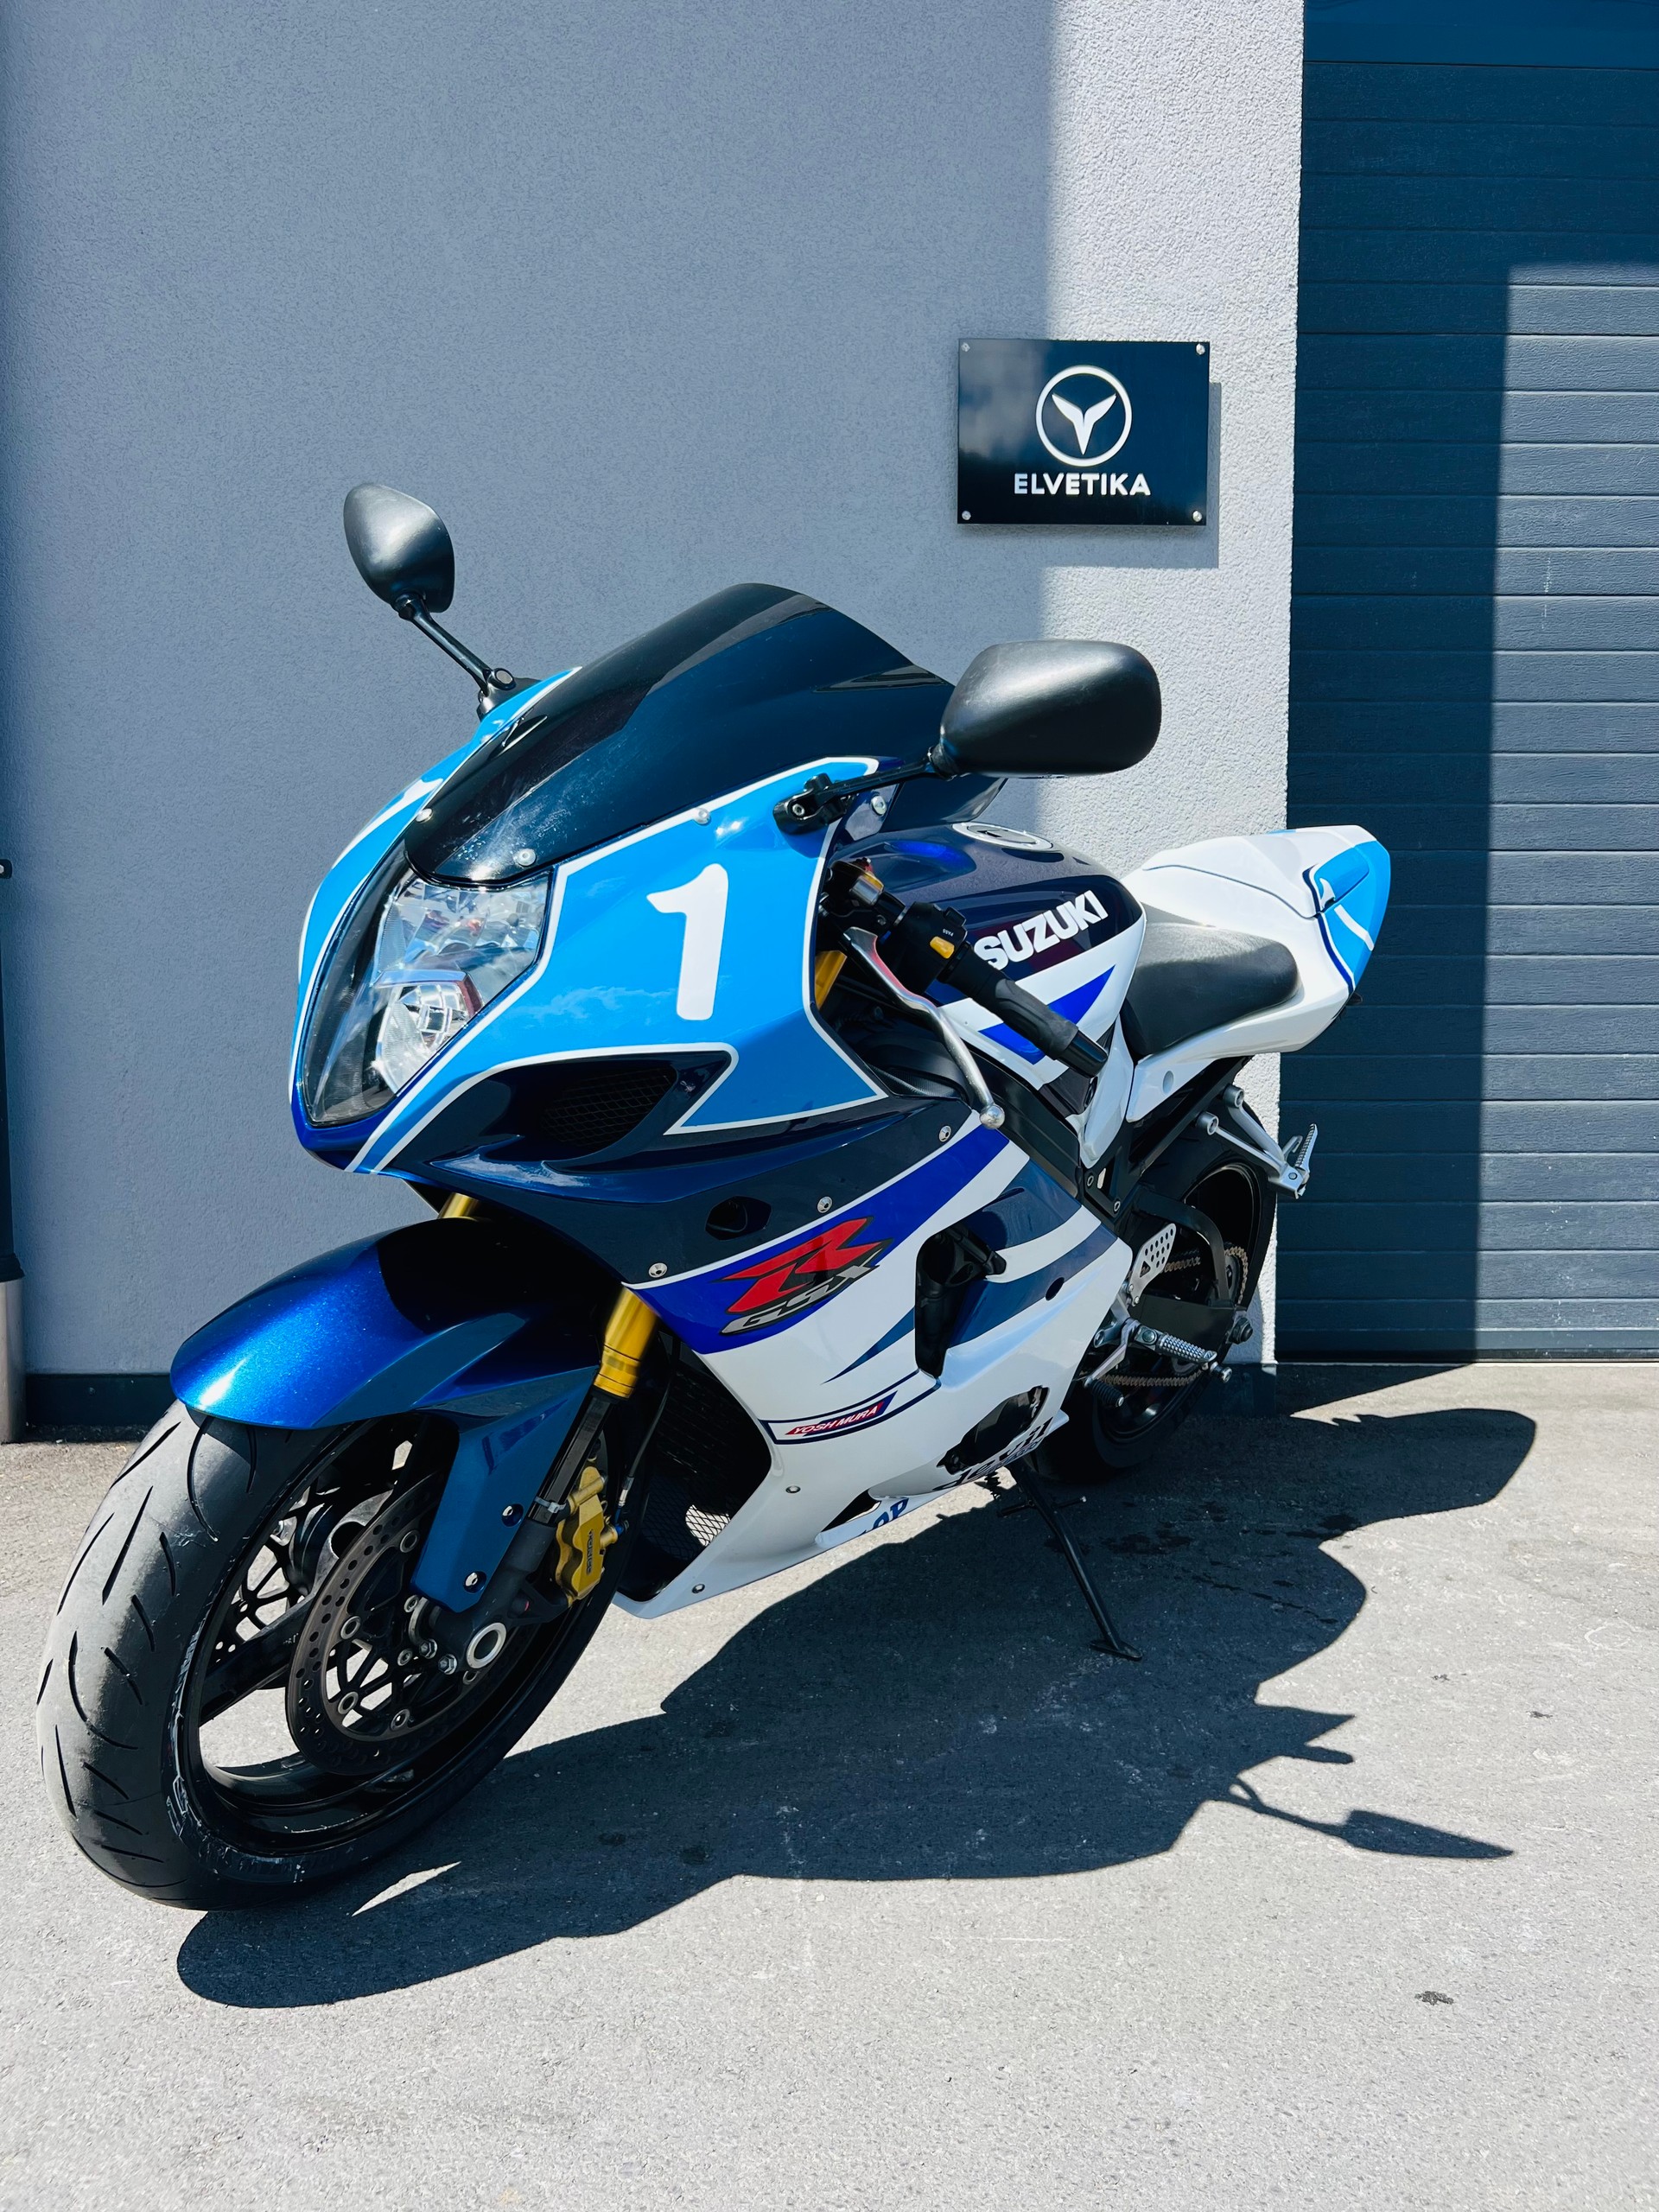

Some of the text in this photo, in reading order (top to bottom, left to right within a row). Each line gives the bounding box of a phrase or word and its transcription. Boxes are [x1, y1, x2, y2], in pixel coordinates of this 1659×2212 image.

[1014, 473, 1151, 496] ELVETIKA
[646, 863, 729, 1020] 1
[974, 890, 1109, 970] SUZUKI
[793, 1405, 878, 1434] YOSHMURA
